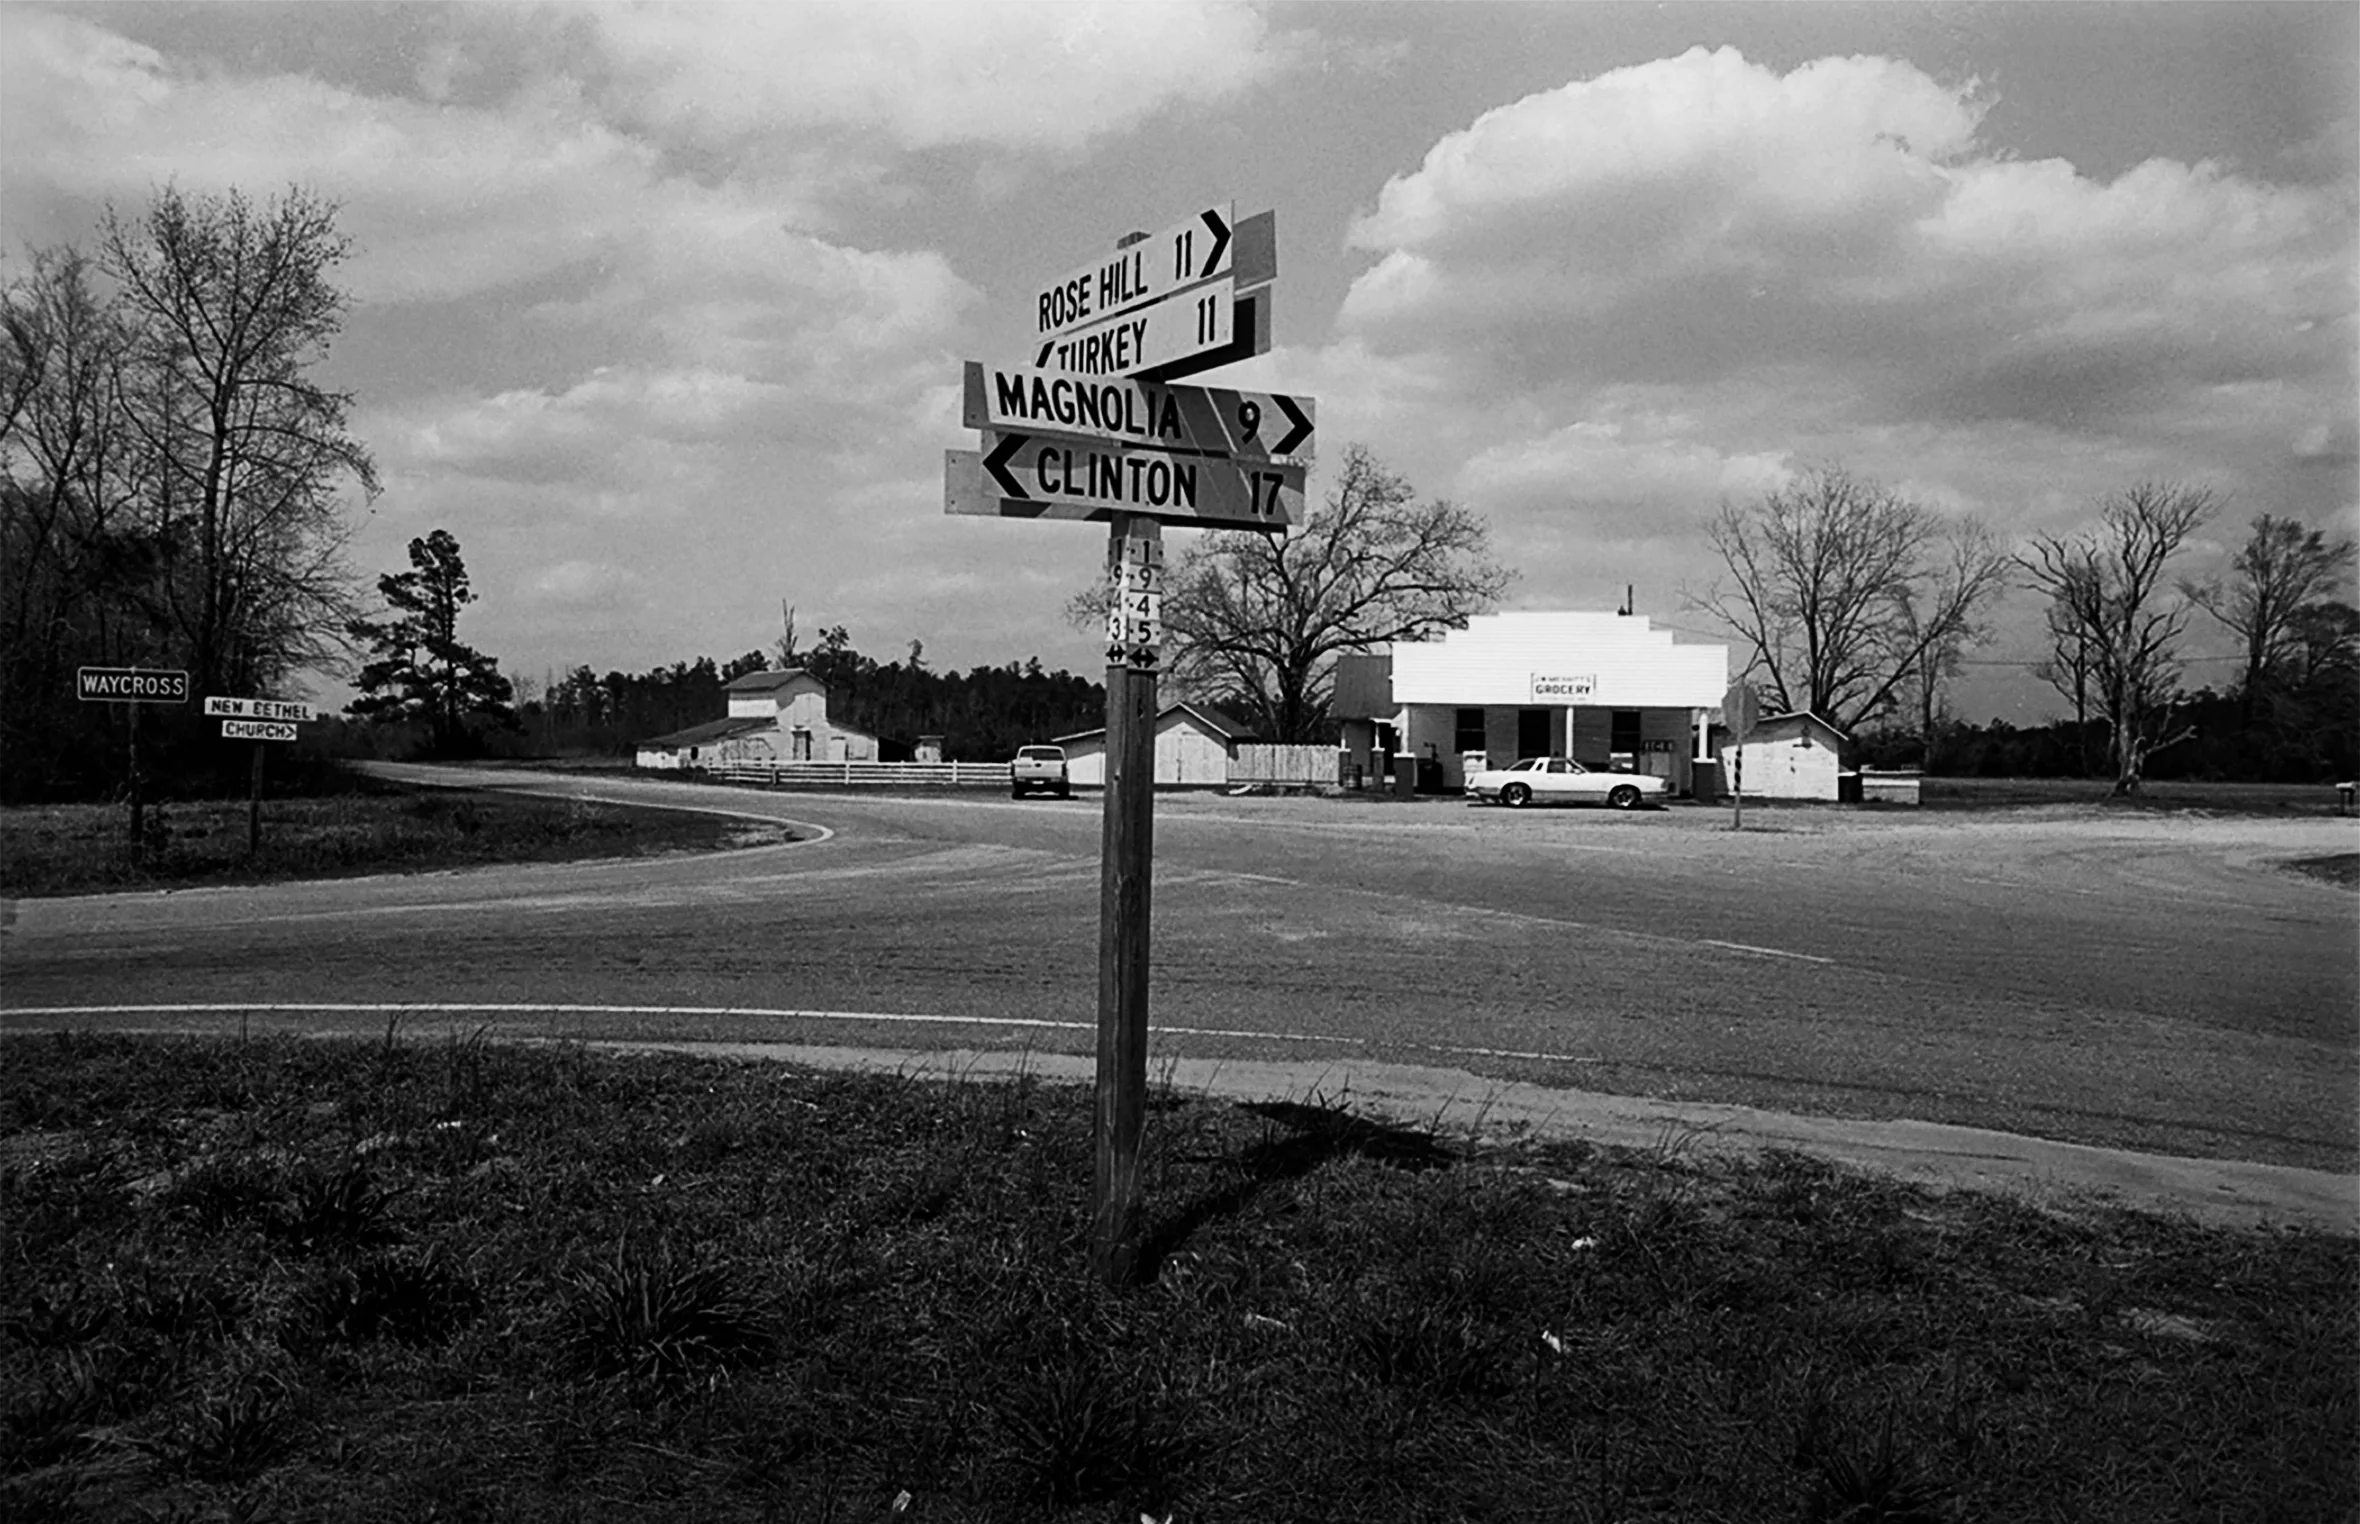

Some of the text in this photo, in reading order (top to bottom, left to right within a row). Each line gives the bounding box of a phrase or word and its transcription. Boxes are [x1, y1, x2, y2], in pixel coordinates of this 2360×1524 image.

[1039, 230, 1192, 332] ROSE HILL 11
[1057, 295, 1215, 374] TURKEY 11
[995, 371, 1260, 444] MAGNOLIA 9
[1037, 446, 1284, 515] CLINTON 17
[83, 675, 184, 695] WAYCROSS
[211, 700, 243, 713] NEW
[1535, 684, 1591, 695] GROCERY
[225, 722, 285, 738] CHURCH
